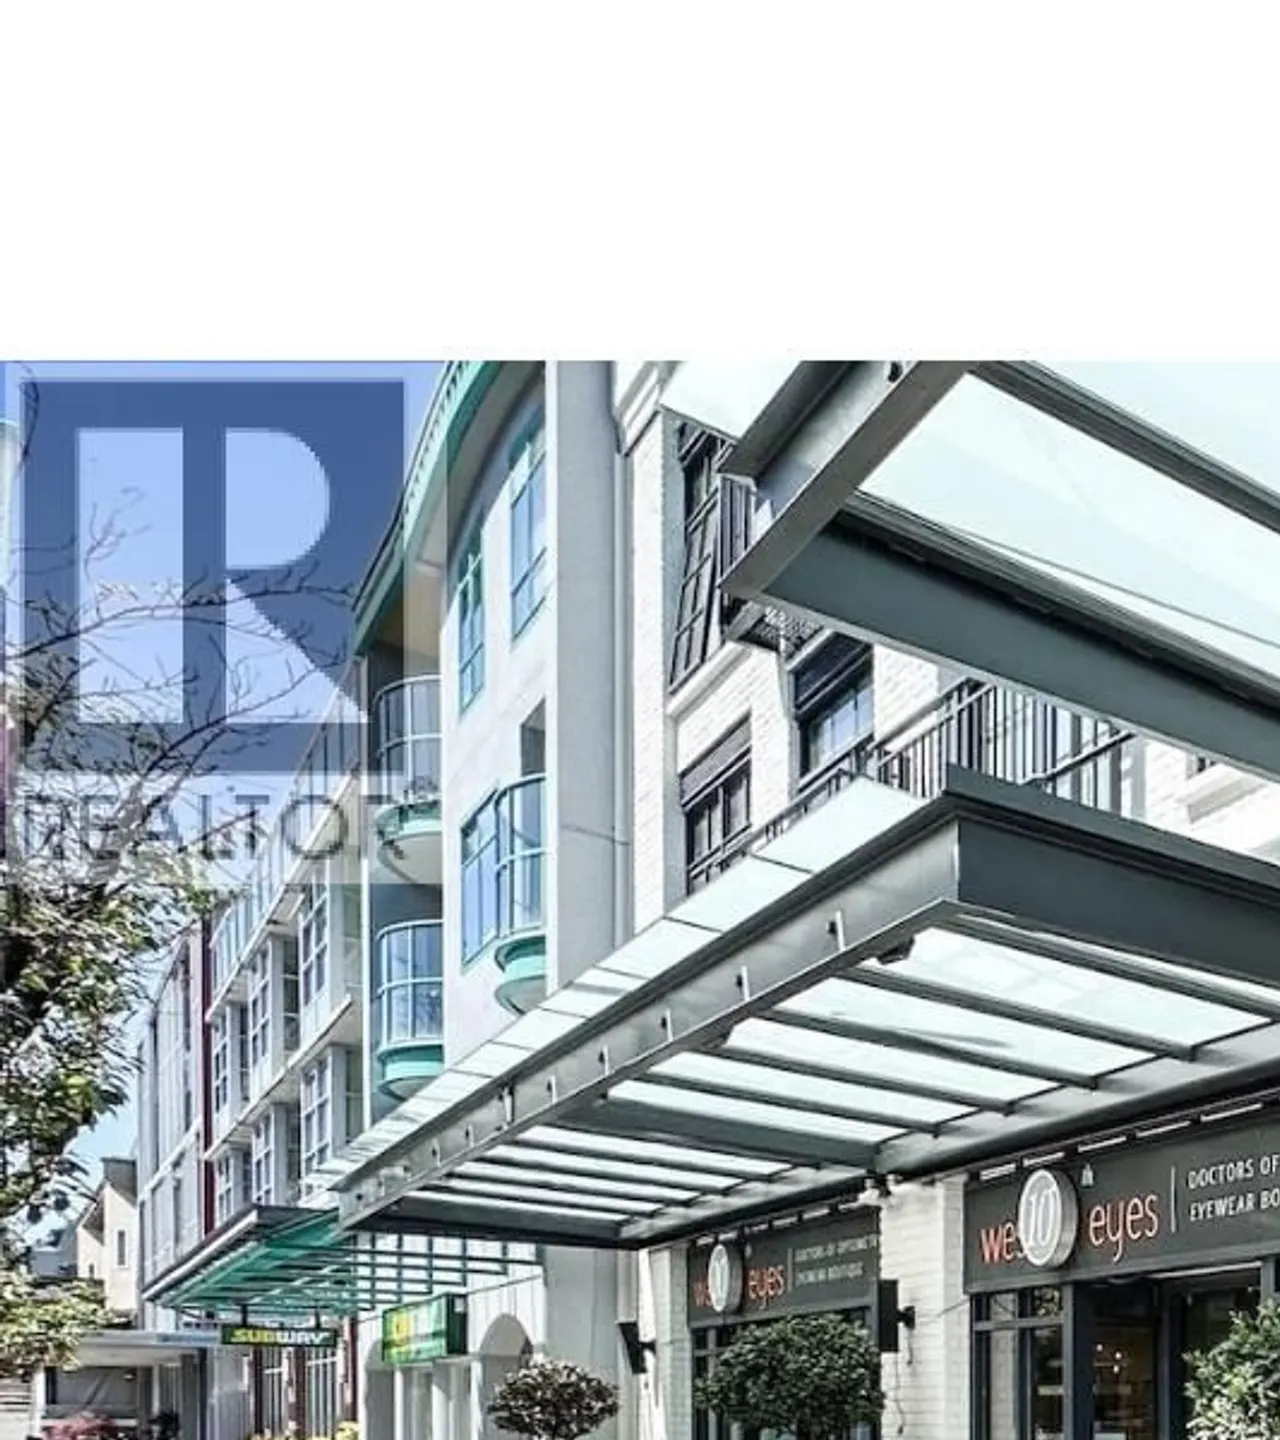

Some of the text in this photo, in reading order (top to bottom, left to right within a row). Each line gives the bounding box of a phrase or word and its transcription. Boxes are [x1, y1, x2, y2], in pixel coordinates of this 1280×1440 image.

[1187, 1158, 1254, 1189] DOCTORS
[1259, 1154, 1280, 1175] OF
[1189, 1192, 1255, 1221] EYEWEAR
[1088, 1194, 1159, 1263] eyes
[230, 1328, 330, 1345] SUBWAY
